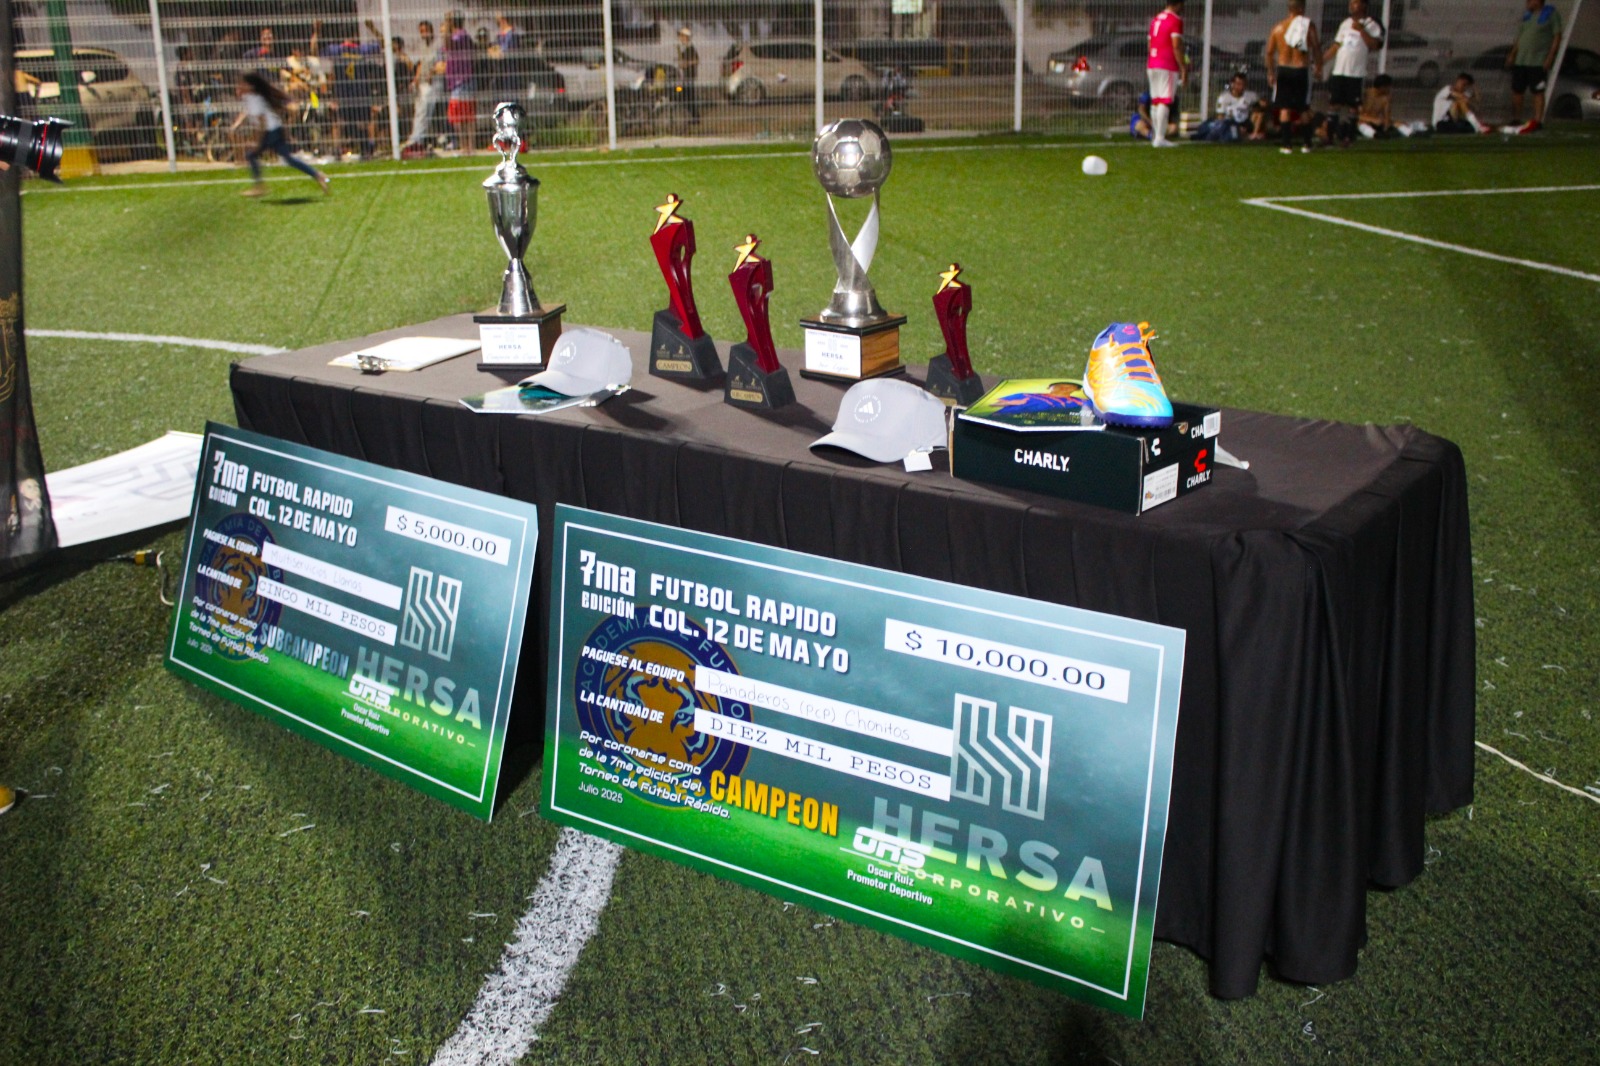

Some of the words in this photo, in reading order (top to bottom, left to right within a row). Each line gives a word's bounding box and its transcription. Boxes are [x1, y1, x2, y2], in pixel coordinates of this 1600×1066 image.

[821, 351, 844, 360] HERSA
[213, 450, 249, 493] 7ma
[1014, 448, 1070, 472] CHARLY
[1186, 469, 1211, 489] CHARLY
[252, 471, 300, 503] FUTBOL
[303, 486, 353, 519] RAPIDO
[203, 528, 229, 545] PAGUESE
[228, 537, 236, 549] AL
[236, 540, 258, 556] EQUIPO
[249, 497, 276, 521] COL.
[279, 505, 292, 527] 12
[293, 510, 312, 533] DE
[312, 516, 358, 547] MAYO
[396, 514, 407, 532] $
[414, 520, 497, 556] 5,000.00
[197, 563, 206, 575] LA
[206, 567, 234, 586] CANTIDAD
[234, 578, 243, 589] DE
[580, 549, 636, 597] 7ma
[258, 580, 298, 604] CINCO
[306, 598, 331, 617] MIL
[341, 610, 386, 637] PESOS
[581, 591, 635, 619] EDICIÓN
[650, 573, 740, 615] FUTBOL
[746, 594, 837, 637] RAPIDO
[260, 622, 349, 678] SUBCAMPEON
[649, 604, 699, 638] COL.
[705, 618, 728, 645] 12
[734, 624, 764, 653] DE
[769, 632, 849, 674] MAYO
[904, 630, 923, 652] $
[936, 638, 1106, 691] 10,000.00
[581, 645, 628, 667] PAGUESE
[626, 657, 643, 673] AL
[645, 663, 686, 683] EQUIPO
[355, 646, 482, 730] HERSA
[580, 690, 595, 705] LA
[595, 694, 649, 719] CANTIDAD
[649, 709, 665, 724] DE
[707, 671, 790, 711] Panaderos
[341, 708, 365, 725] Promotor
[364, 717, 390, 736] Deportivo
[579, 731, 602, 745] Por
[603, 739, 667, 765] coronarse
[668, 759, 702, 776] como
[579, 747, 593, 758] de
[596, 750, 607, 763] la
[610, 755, 634, 772] 7ma
[635, 765, 679, 785] edición
[682, 778, 703, 793] del
[710, 717, 768, 745] DIEZ
[785, 738, 832, 762] MIL
[850, 755, 932, 790] PESOS
[578, 762, 620, 784] Torneo
[622, 777, 638, 789] de
[639, 782, 682, 804] Fútbol
[684, 795, 732, 819] Rápido.
[578, 781, 600, 796] Julio
[600, 788, 624, 804] 2025
[709, 769, 839, 837] CAMPEON
[867, 863, 893, 879] Oscar
[894, 871, 915, 887] Ruiz
[872, 796, 1113, 912] HERSA
[847, 869, 888, 891] Promotor
[889, 883, 933, 905] Deportivo
[897, 863, 1084, 929] CORPORATIVO
